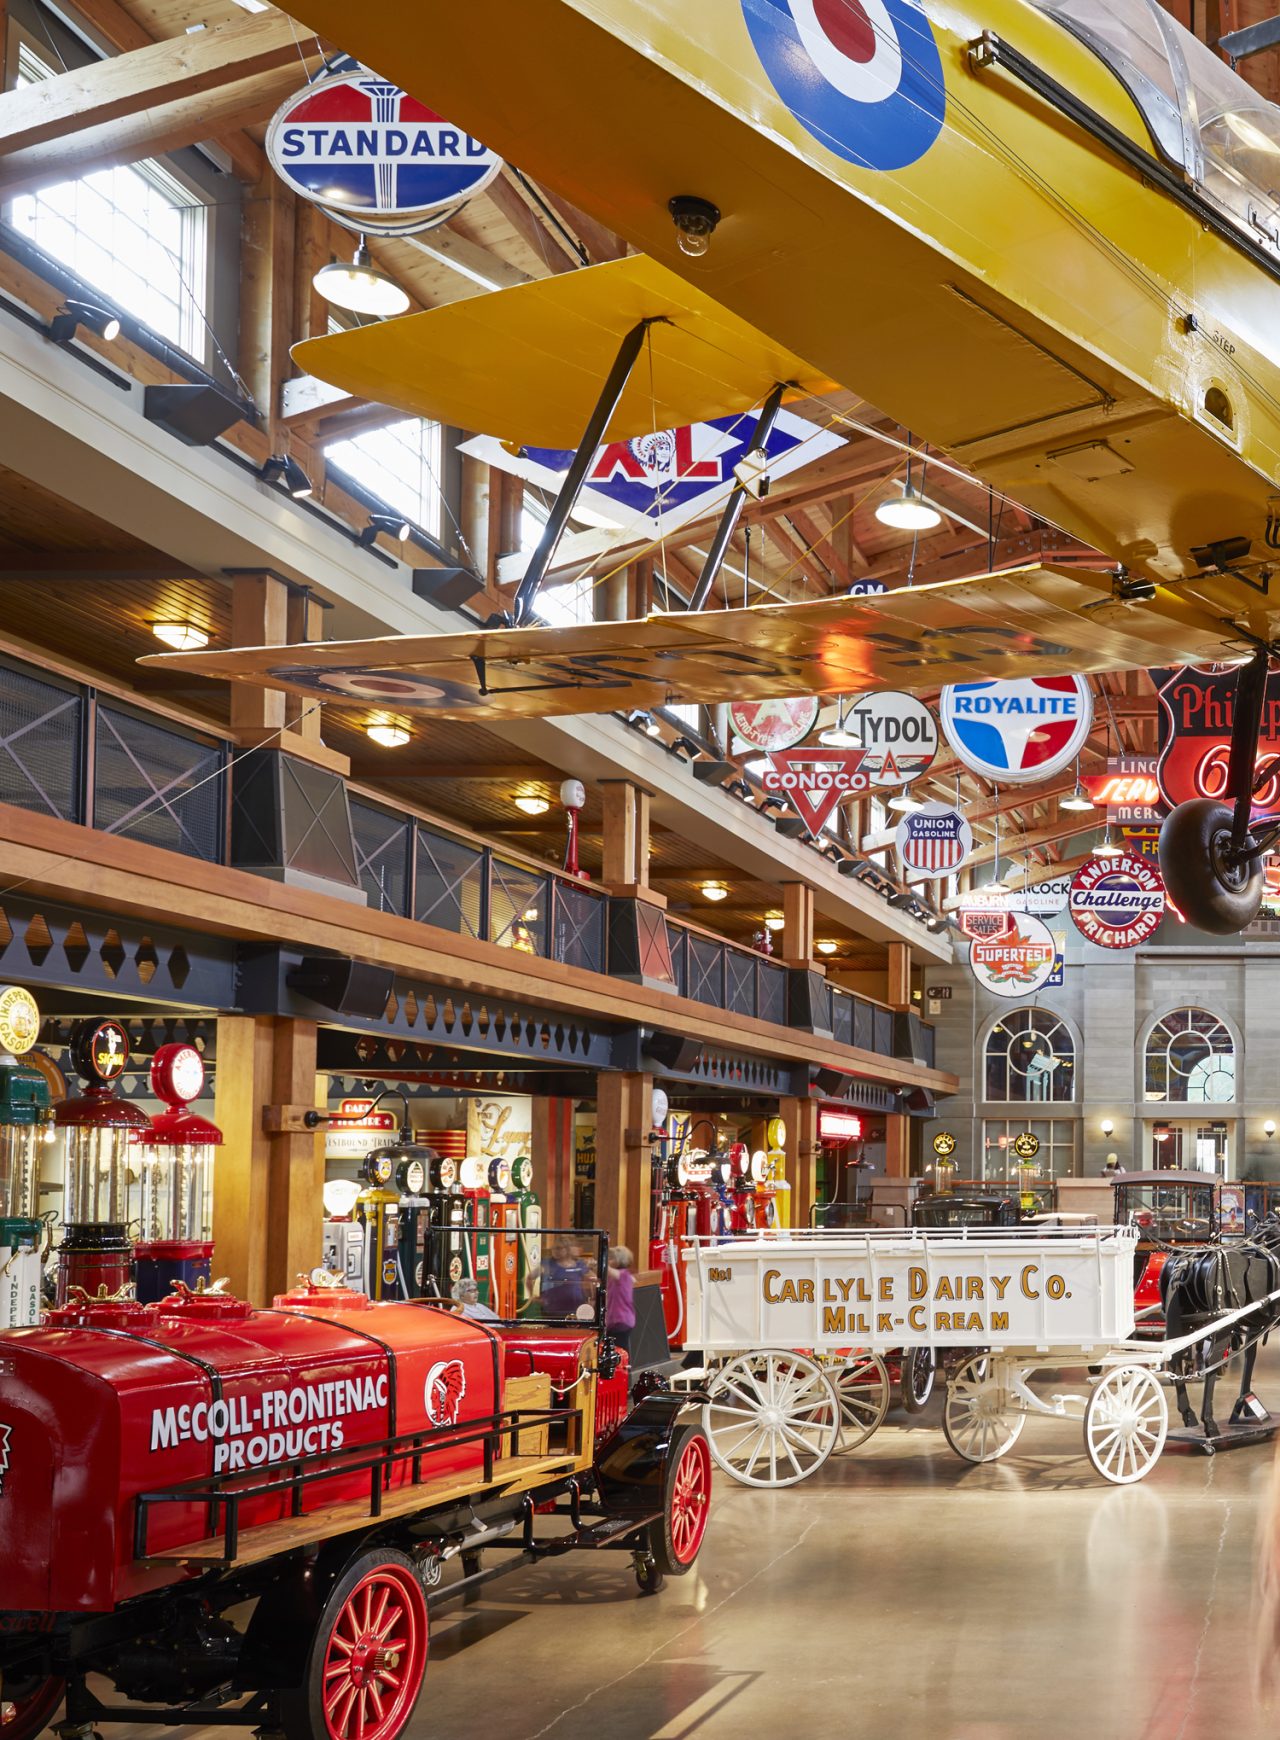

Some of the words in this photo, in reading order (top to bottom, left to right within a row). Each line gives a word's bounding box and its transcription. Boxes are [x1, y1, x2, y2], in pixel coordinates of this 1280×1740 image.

[281, 129, 488, 157] STANDARD
[1212, 330, 1236, 355] STEP
[955, 696, 1077, 715] ROYALITE
[853, 708, 934, 749] TYDOL
[765, 772, 868, 791] CONOCO
[914, 819, 955, 829] UNION
[1080, 859, 1158, 891] ANDERSON
[1073, 889, 1162, 910] Challenge
[966, 915, 1003, 925] SERVICE
[972, 925, 998, 935] SALES
[1077, 911, 1157, 945] PRICHARD
[976, 945, 1053, 962] SUPERTEST
[213, 1420, 346, 1473] PRODUCTS
